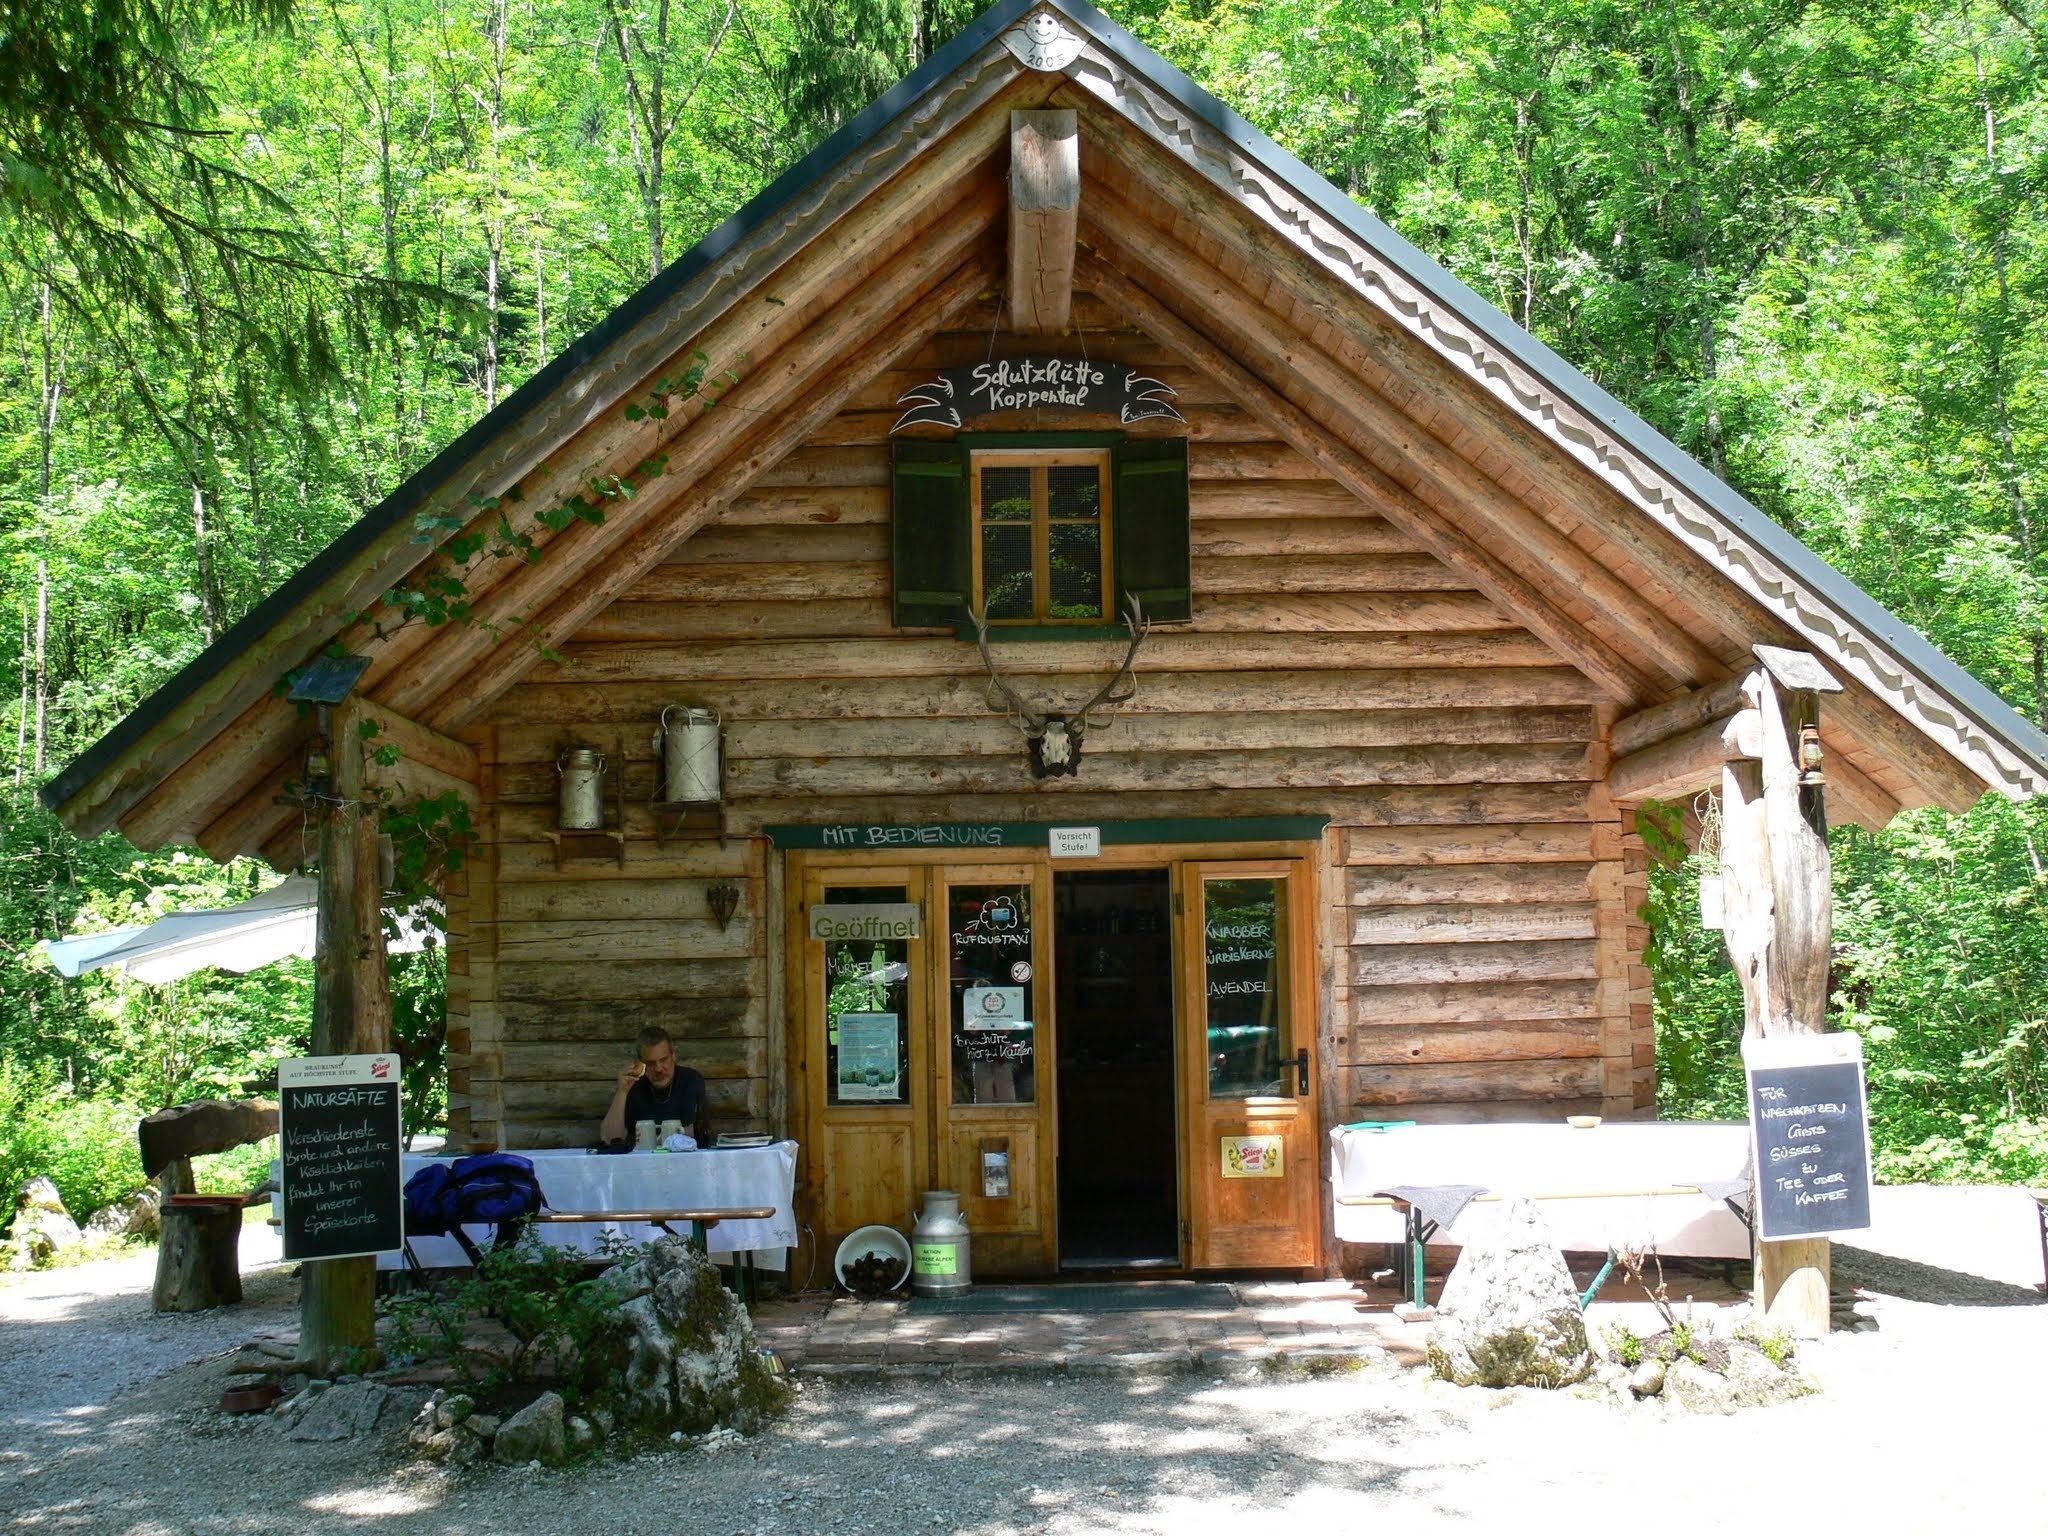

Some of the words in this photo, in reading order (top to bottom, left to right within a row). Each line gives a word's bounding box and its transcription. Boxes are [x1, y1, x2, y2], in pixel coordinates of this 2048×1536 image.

[970, 359, 1104, 395] Schutzhütte
[990, 386, 1089, 410] Koppental
[822, 825, 858, 844] MIT
[865, 825, 1003, 845] BEDIENUNG
[1057, 832, 1092, 840] Vorsicht
[1061, 843, 1088, 851] Stufe!
[815, 917, 916, 938] Geöffnet
[952, 928, 1030, 945] RUFBUSTAXI
[1207, 946, 1275, 965] ÜRBISKERNE
[293, 1088, 388, 1109] NATURSÄFTE
[1757, 1087, 1787, 1100] FÜR
[1760, 1103, 1846, 1120] NASCHKATZEN
[287, 1118, 377, 1146] Verschiedenste
[286, 1148, 318, 1166] Brote
[320, 1144, 344, 1159] und
[1769, 1144, 1822, 1161] SÜSSES
[1776, 1178, 1804, 1191] TEE
[1813, 1172, 1845, 1185] ODER
[289, 1184, 325, 1206] findet
[316, 1197, 361, 1211] unserer
[1795, 1188, 1848, 1206] KAFFEE
